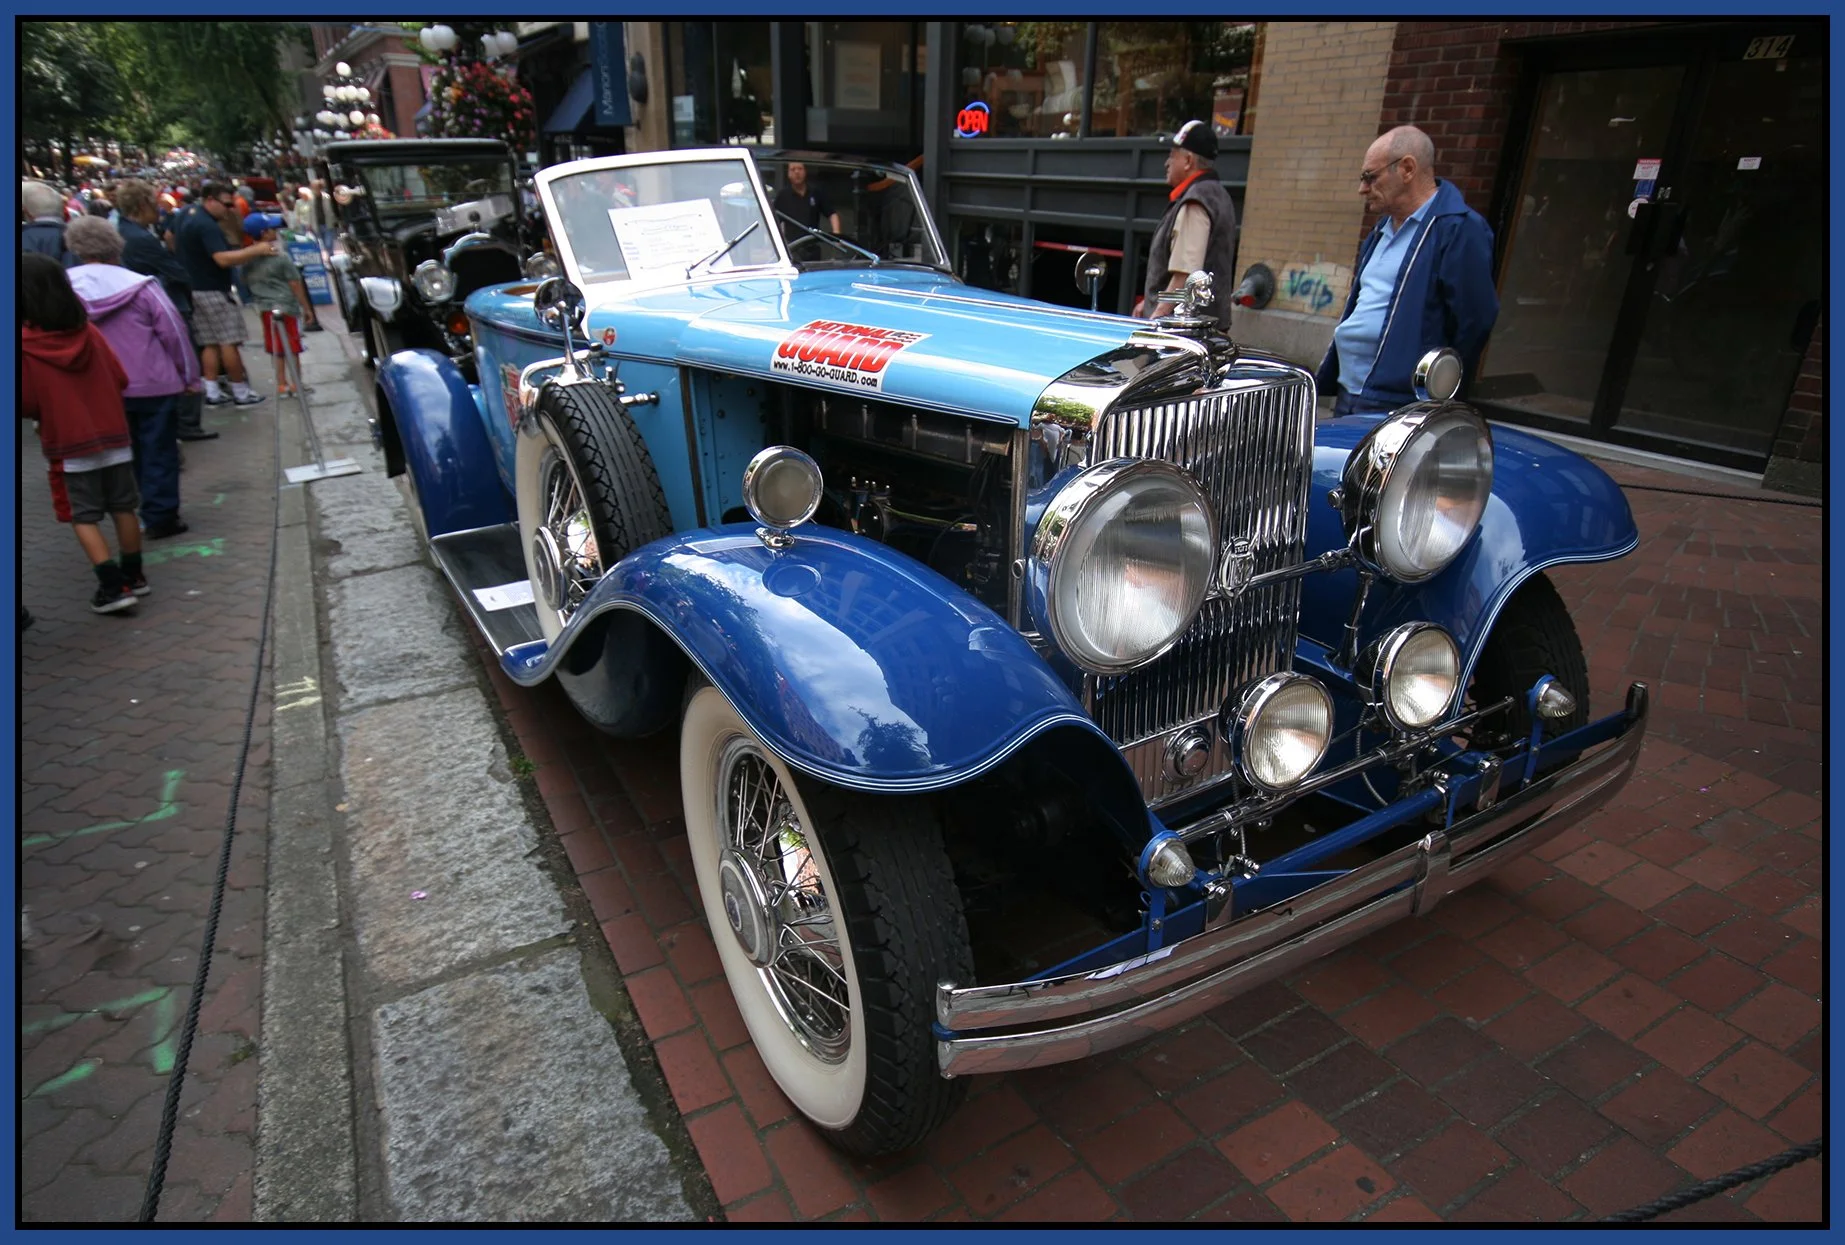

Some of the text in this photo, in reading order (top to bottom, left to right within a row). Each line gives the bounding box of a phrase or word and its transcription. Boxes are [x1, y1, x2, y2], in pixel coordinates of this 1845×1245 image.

[1747, 36, 1791, 58] 314
[957, 109, 988, 132] OPEN
[804, 320, 893, 339] NATIONAL
[777, 329, 904, 373] GUARD
[773, 360, 878, 388] www.1-800-GO-GUARD.com
